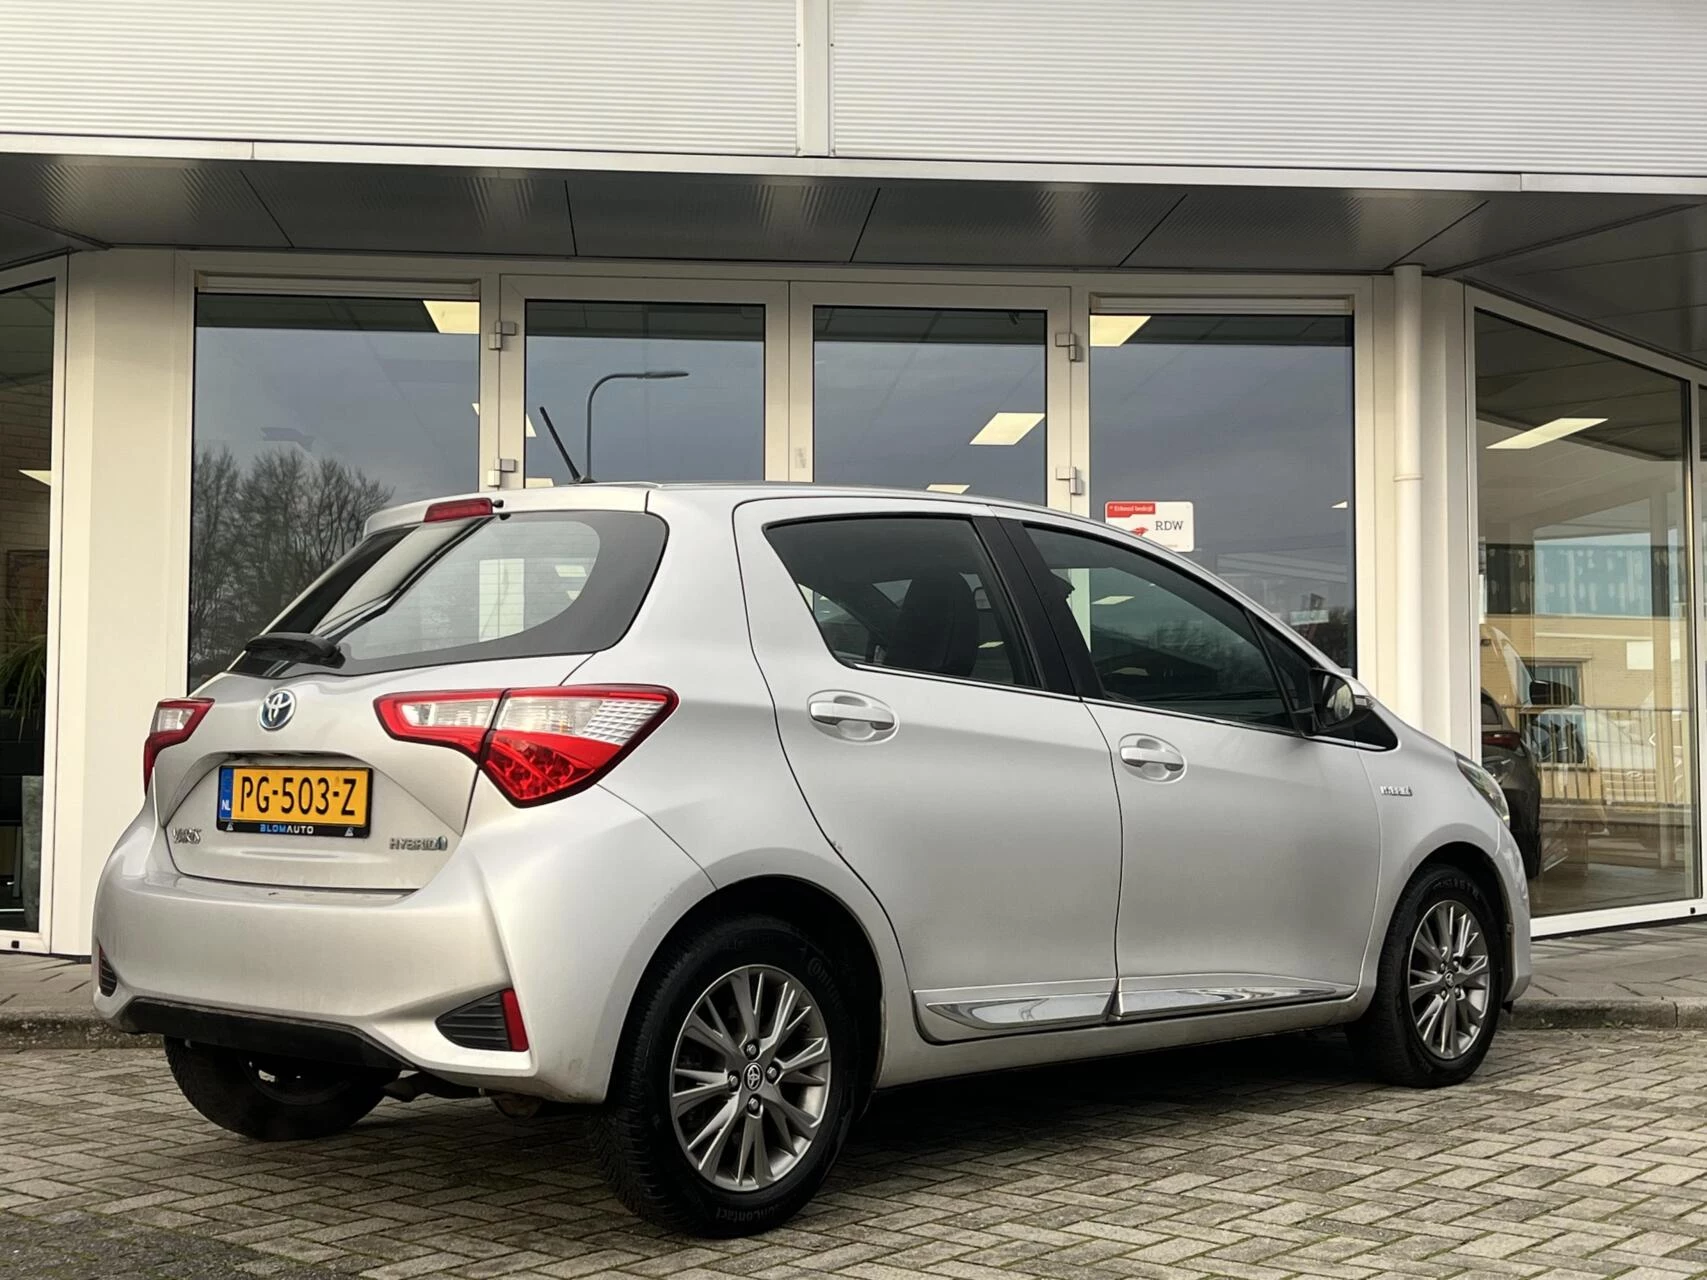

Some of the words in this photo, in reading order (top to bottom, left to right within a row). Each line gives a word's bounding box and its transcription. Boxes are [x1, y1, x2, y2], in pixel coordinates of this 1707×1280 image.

[1155, 520, 1184, 531] RDW
[240, 775, 356, 817] PG-503-Z
[221, 799, 231, 811] NL
[259, 823, 314, 835] BLOMAUTO
[389, 837, 439, 851] HYBRID
